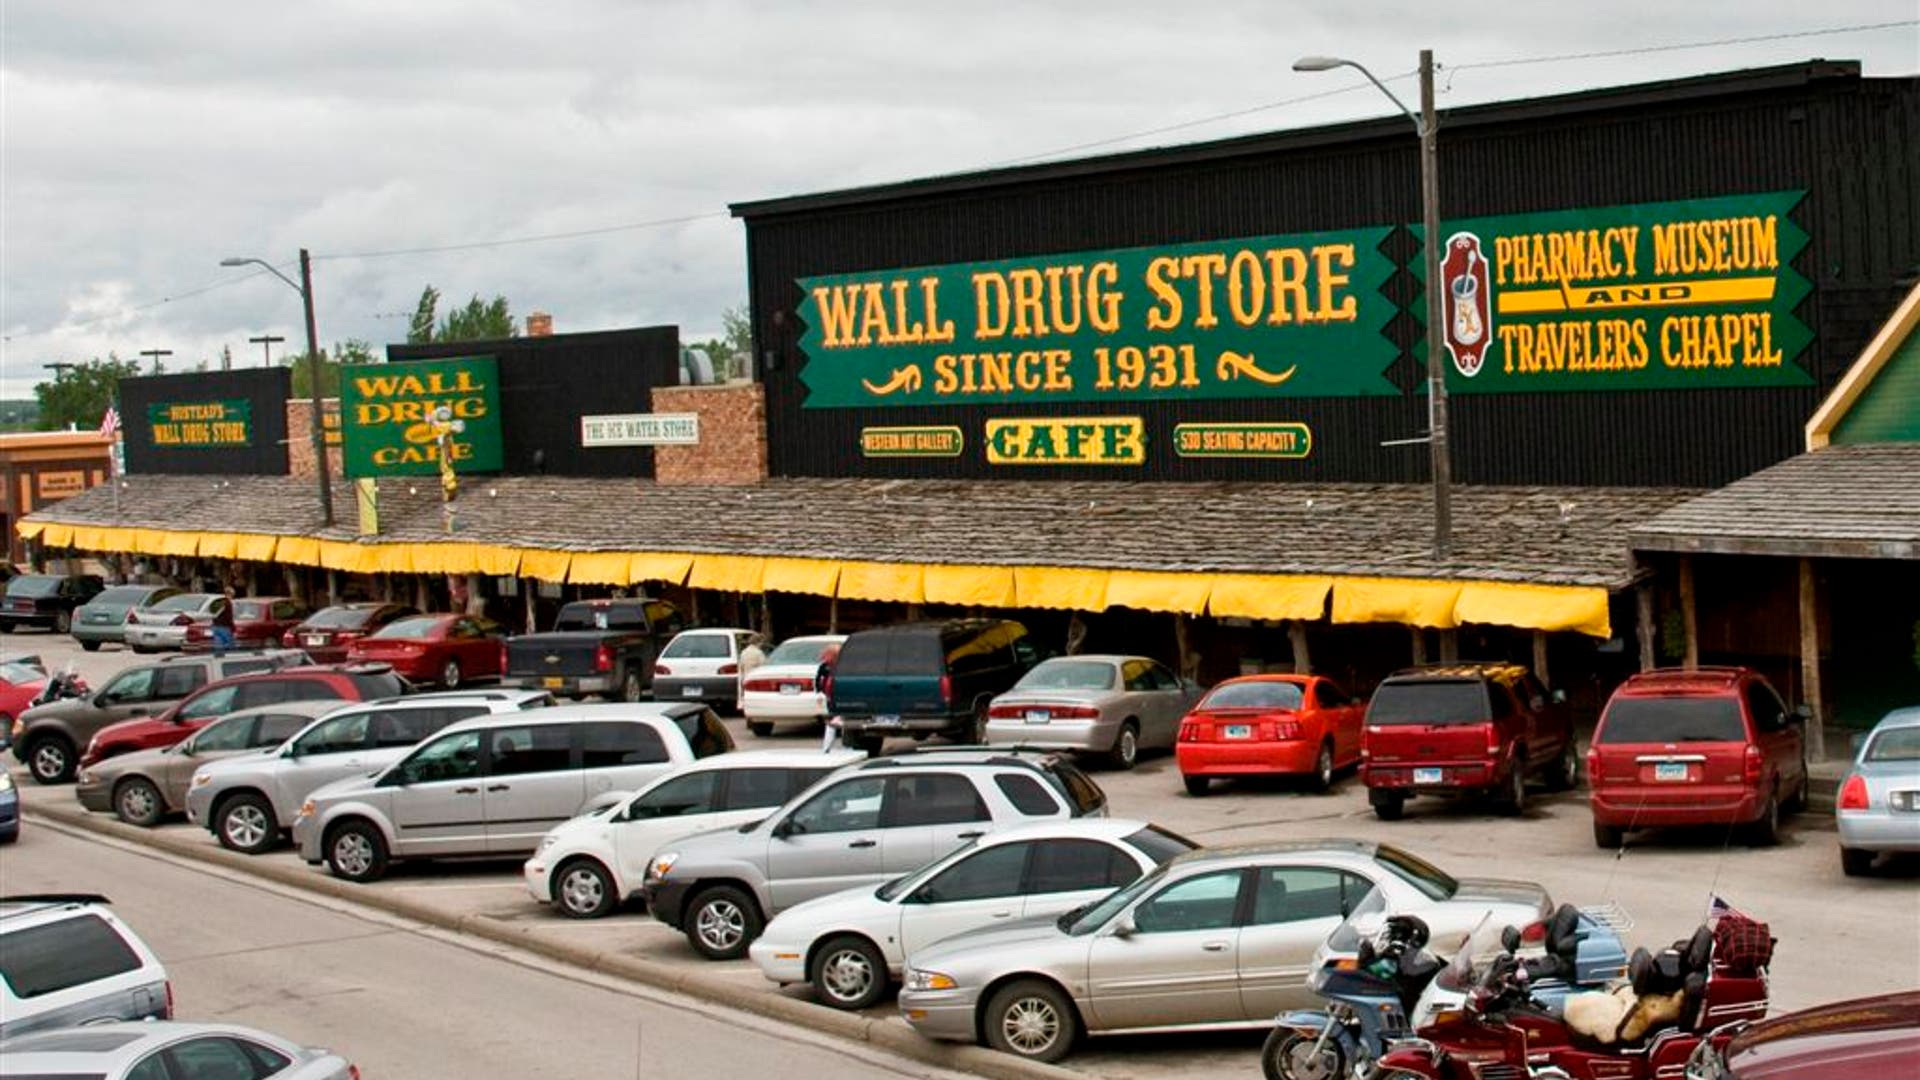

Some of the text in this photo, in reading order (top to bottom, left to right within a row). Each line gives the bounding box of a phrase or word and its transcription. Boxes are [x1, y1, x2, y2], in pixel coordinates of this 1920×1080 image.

[1494, 215, 1779, 286] PHARMACY MUSEUM
[812, 242, 1358, 348] WALL DRUG STORE
[1585, 285, 1692, 304] AND
[1497, 311, 1783, 374] TRAVELERS CHAPEL
[933, 343, 1201, 394] SINCE 1931
[355, 370, 485, 398] WALL
[153, 420, 246, 444] WALL DRUG STORE
[585, 419, 695, 440] THE ICE WATER STORE
[863, 434, 899, 450] WESTERN
[917, 432, 953, 450] GALLERY
[993, 424, 1134, 459] CAFE
[1180, 431, 1297, 451] 530 SEATING CAPACITY
